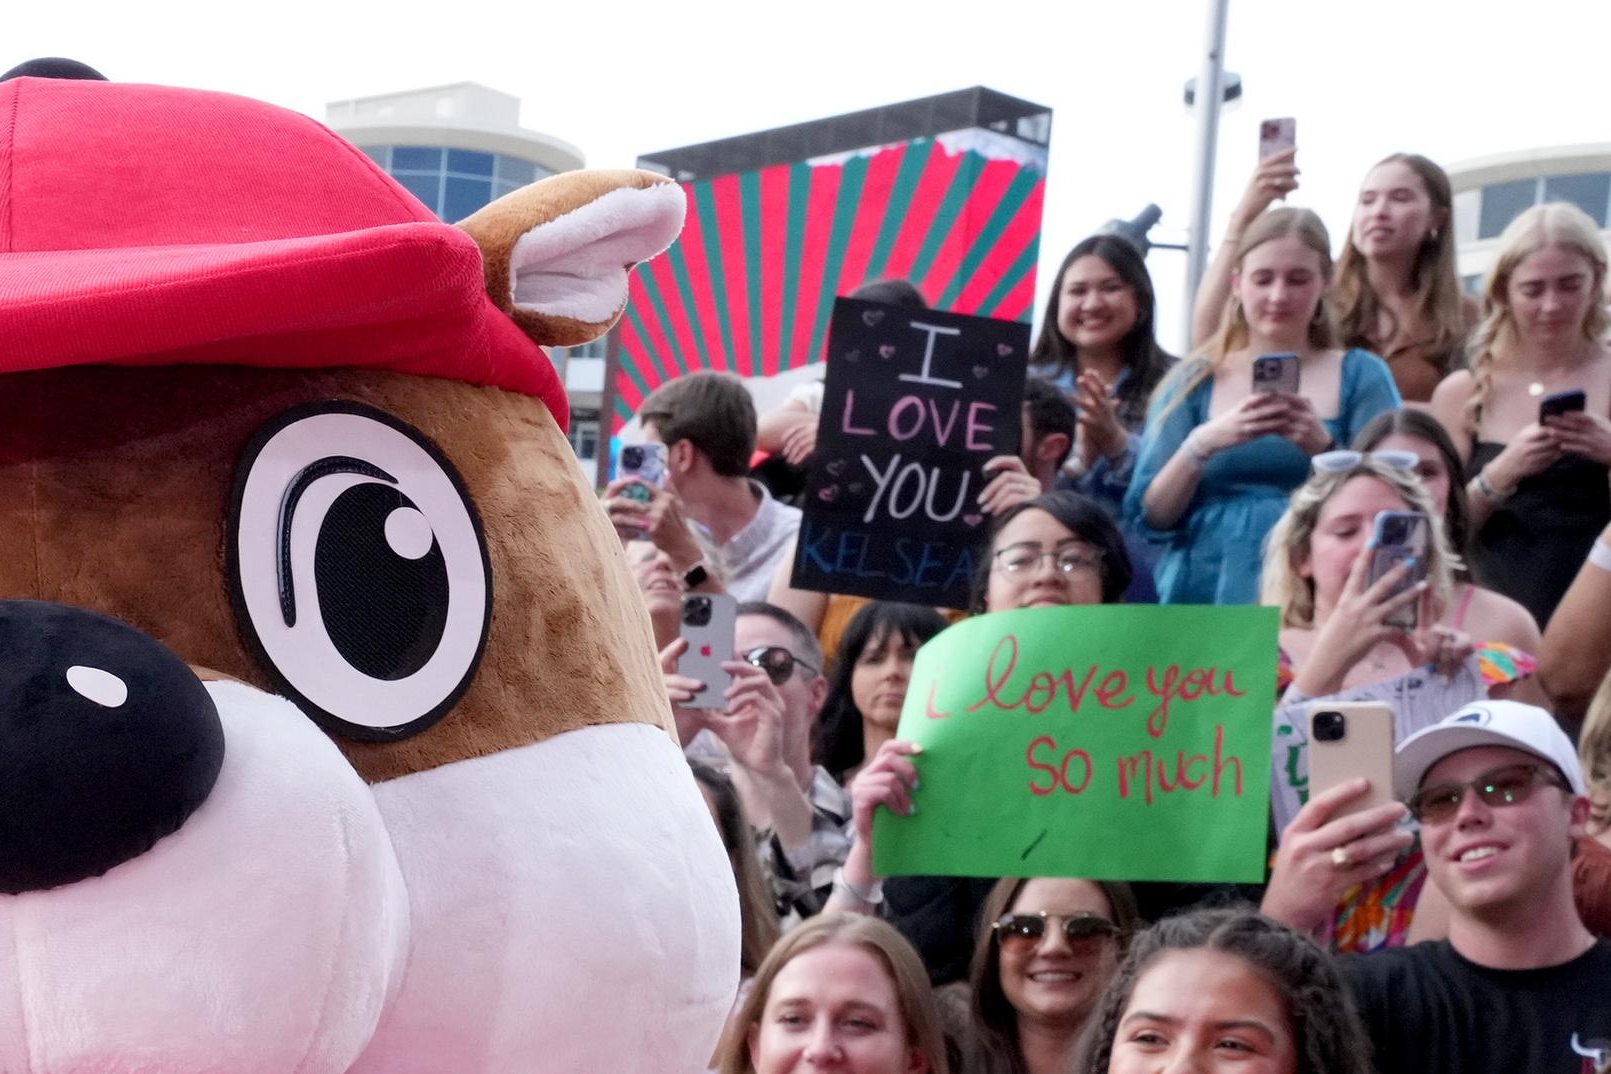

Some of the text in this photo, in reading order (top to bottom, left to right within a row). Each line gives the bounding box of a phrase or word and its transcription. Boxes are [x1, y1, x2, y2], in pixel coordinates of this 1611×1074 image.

[899, 321, 963, 389] I
[842, 390, 997, 450] LOVE
[860, 453, 970, 523] YOU
[966, 634, 1136, 714] love
[1146, 664, 1245, 738] you
